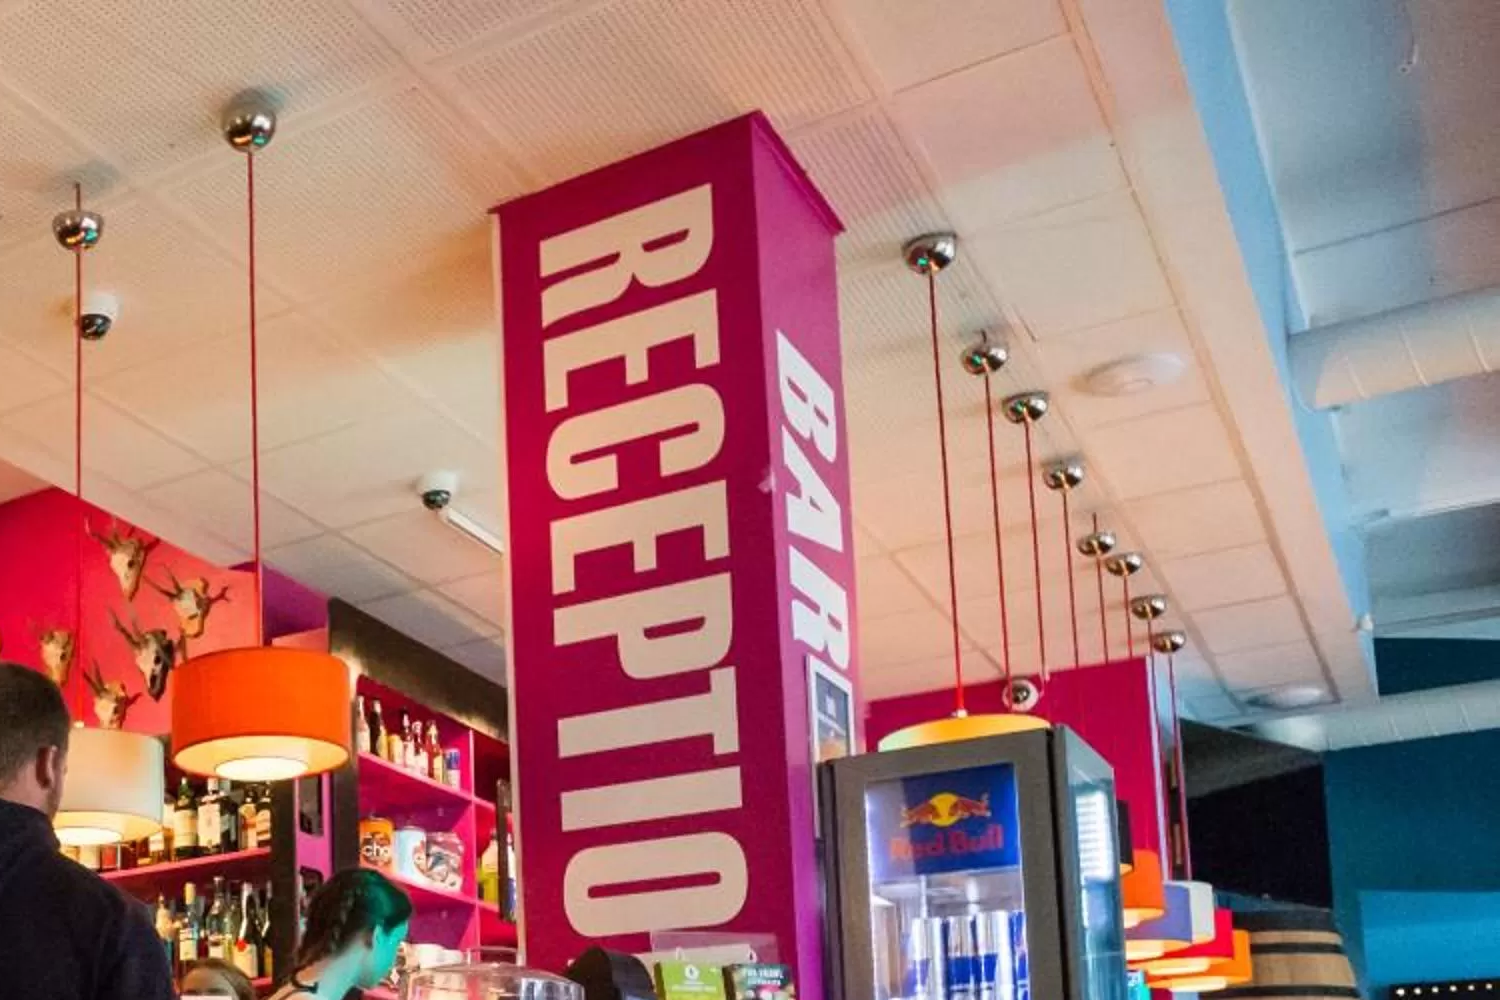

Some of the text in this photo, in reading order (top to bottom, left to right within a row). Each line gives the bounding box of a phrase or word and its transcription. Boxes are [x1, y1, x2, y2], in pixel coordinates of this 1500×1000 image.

[539, 183, 750, 965] RECEPTIO
[776, 330, 850, 670] BAR
[890, 824, 1003, 859] Red Bull
